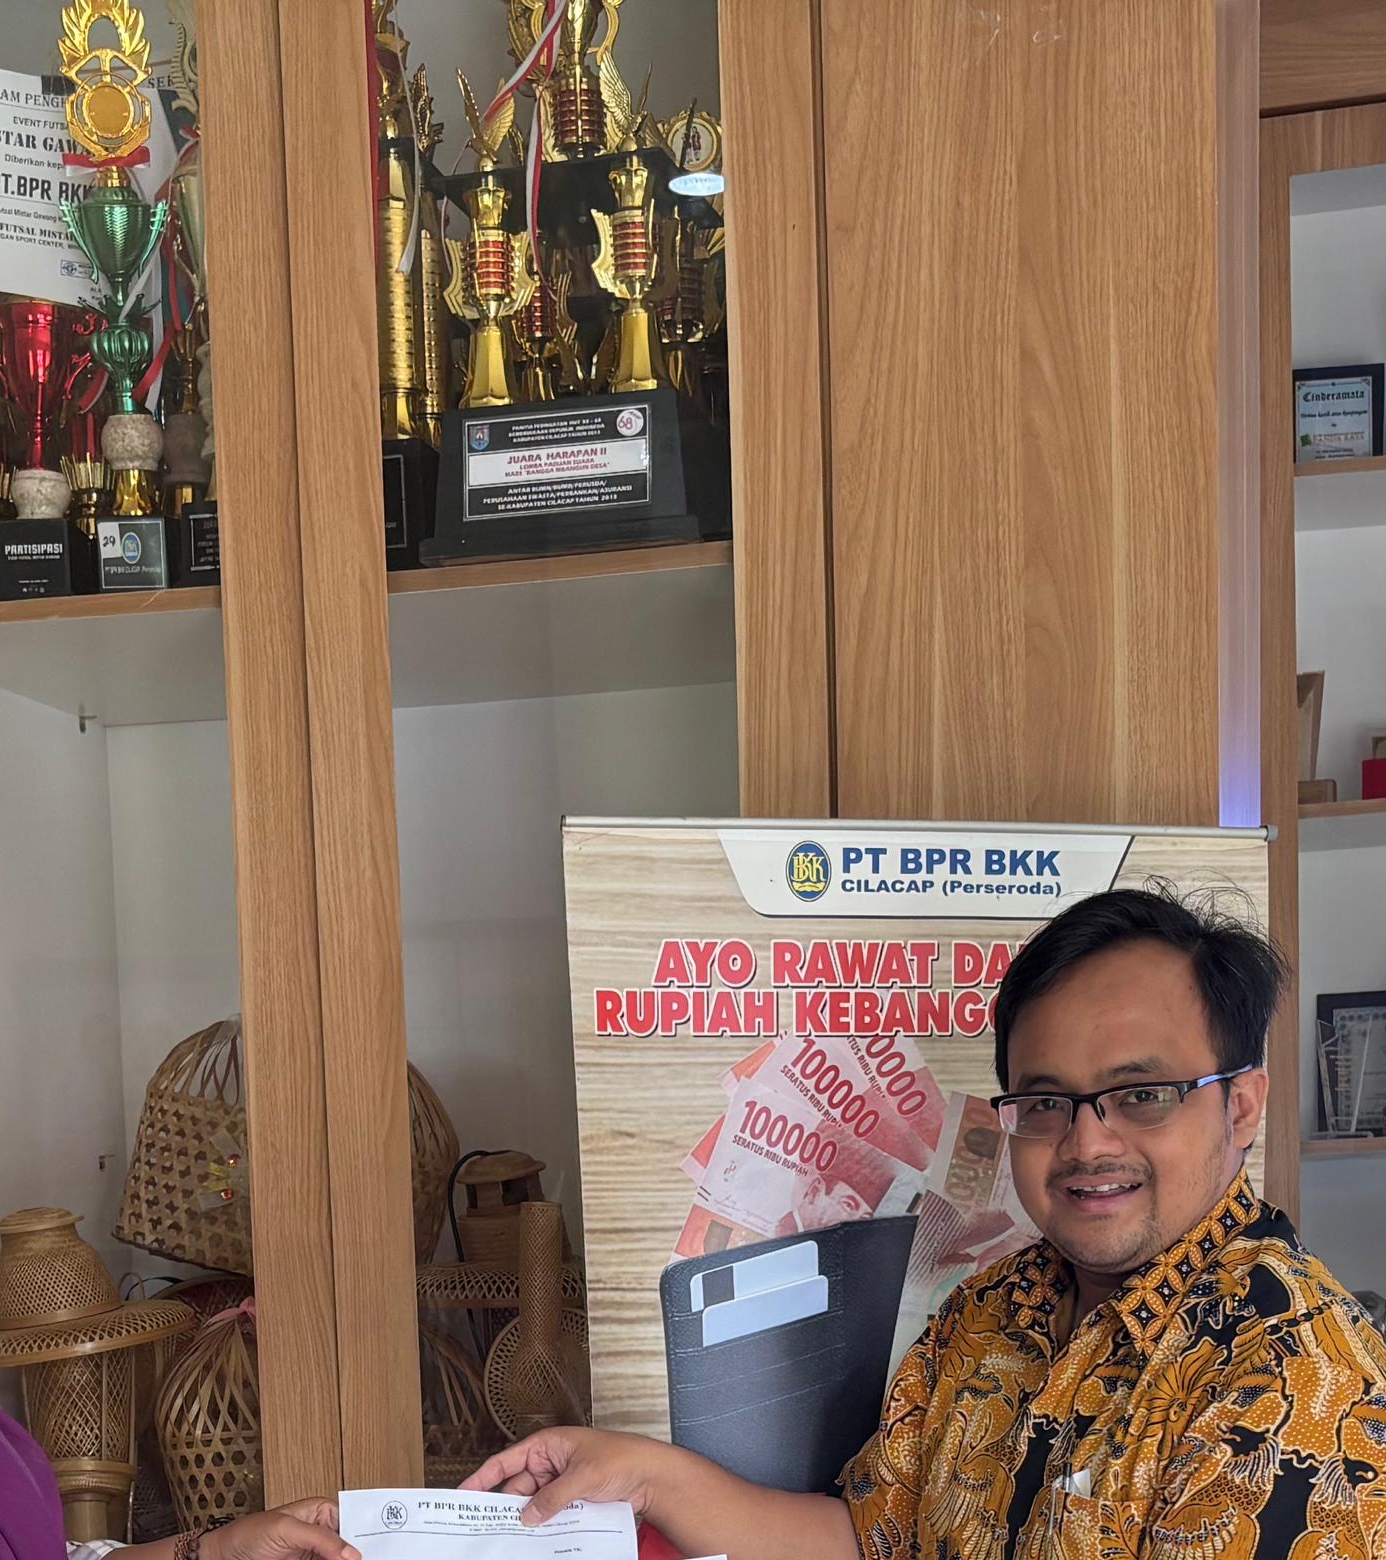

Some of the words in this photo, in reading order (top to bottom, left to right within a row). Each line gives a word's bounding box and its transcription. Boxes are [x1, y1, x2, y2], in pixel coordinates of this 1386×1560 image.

[13, 116, 41, 128] EVENT
[43, 119, 69, 131] FUTSA
[4, 153, 44, 167] Diberikan
[0, 221, 37, 236] FUTSAL
[507, 453, 542, 465] JUARA
[546, 449, 598, 461] HARAPAN
[600, 447, 607, 455] II
[4, 543, 63, 556] PARTISIPASI
[841, 847, 887, 874] PT
[900, 848, 973, 876] BPR
[984, 849, 1062, 877] BKK
[840, 879, 935, 894] CILACAP
[942, 879, 1062, 898] (Perseroda)
[653, 939, 756, 990] AYO
[772, 940, 939, 989] RAWAT
[952, 940, 1028, 989] DA
[594, 989, 783, 1037] RUPIAH
[794, 989, 1000, 1038] KEBANG
[780, 1064, 811, 1099] SERATUS
[808, 1093, 825, 1113] RIBU
[790, 1037, 880, 1139] 100000
[739, 1100, 839, 1173] 100000
[732, 1133, 765, 1157] SERATUS
[763, 1147, 783, 1165] RIBU
[417, 1501, 431, 1511] PT
[433, 1501, 457, 1511] BPR
[458, 1504, 482, 1513] BKK
[483, 1505, 523, 1514] CILACA
[458, 1513, 509, 1521] KABUPATEN
